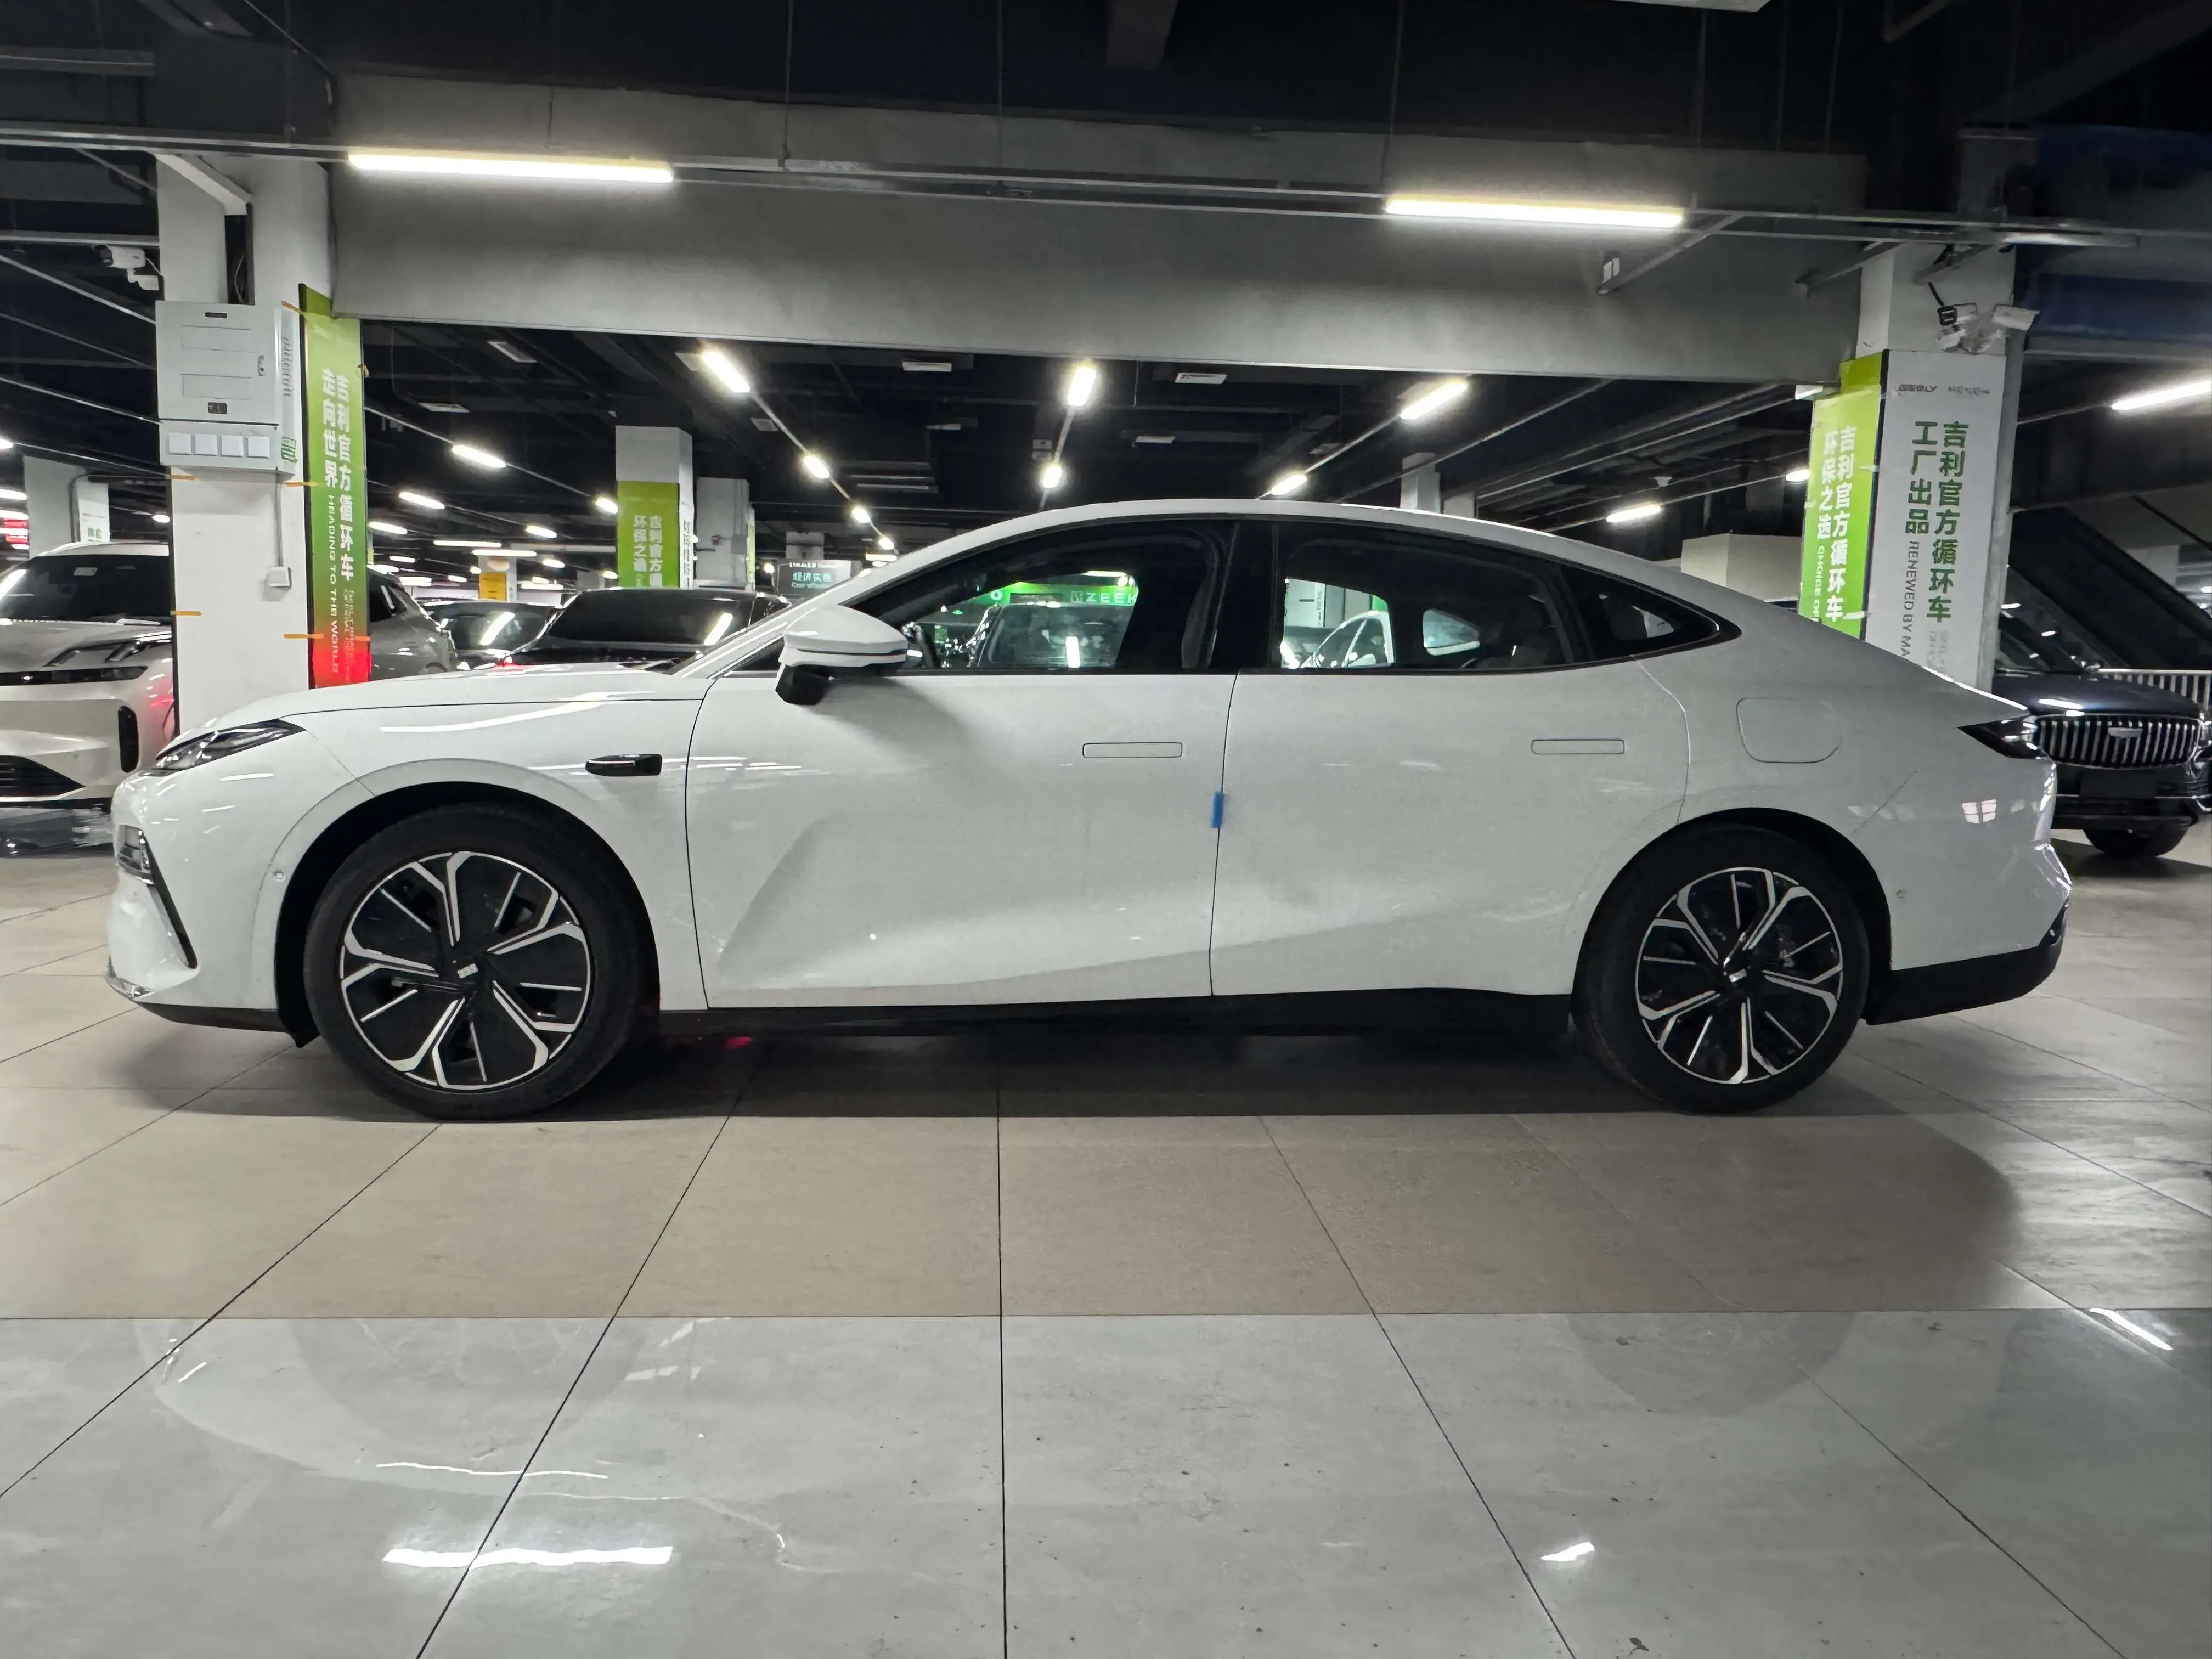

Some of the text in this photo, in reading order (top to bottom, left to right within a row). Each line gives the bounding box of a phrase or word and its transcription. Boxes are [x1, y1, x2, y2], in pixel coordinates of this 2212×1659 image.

[322, 368, 338, 488] 走向世界
[336, 375, 354, 582] 吉利官方循环车
[1905, 421, 1938, 534] 工厂出品
[328, 494, 336, 561] HEADING
[330, 565, 336, 584] TO
[1826, 426, 1857, 622] 吉利官方循环车
[1904, 541, 1920, 611] RENEWED
[1927, 421, 1969, 623] 吉利官方循环车
[1903, 614, 1913, 633] BY
